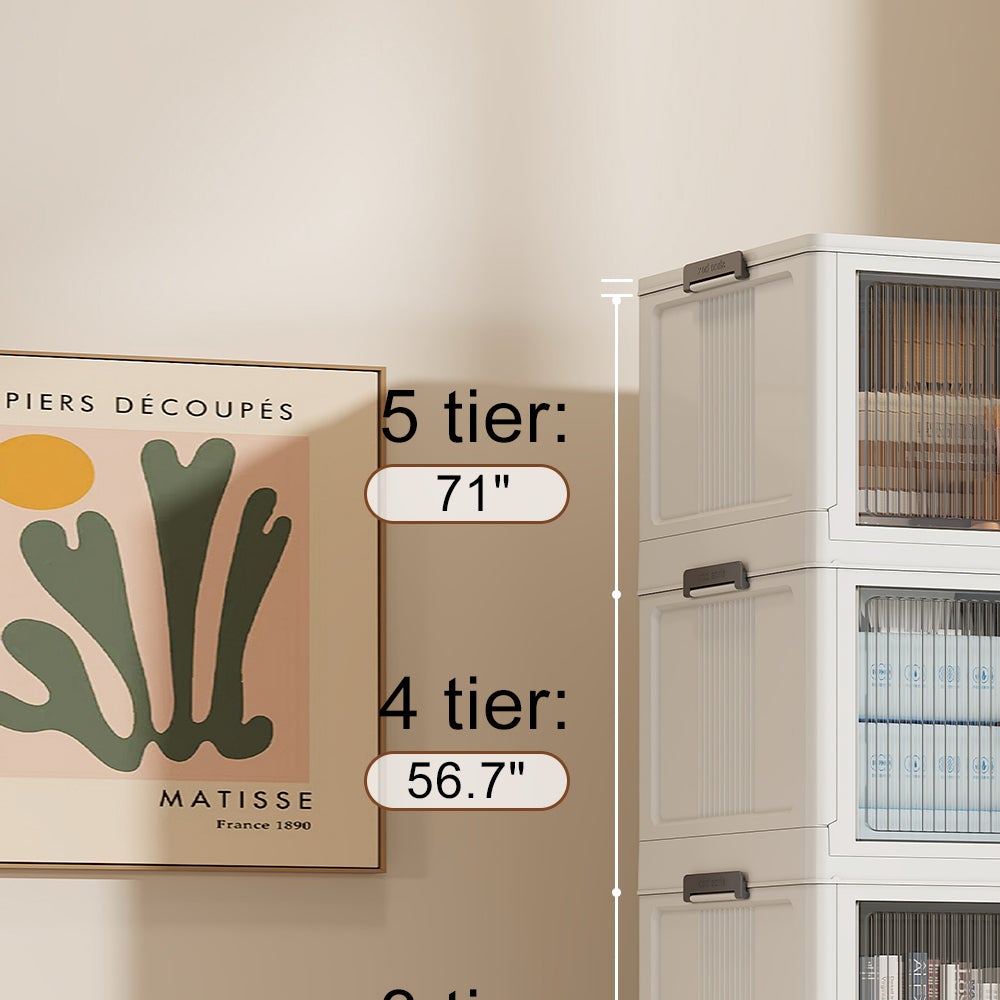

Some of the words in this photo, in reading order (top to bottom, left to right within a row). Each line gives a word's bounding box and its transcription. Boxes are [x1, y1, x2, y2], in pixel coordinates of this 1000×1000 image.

[6, 392, 94, 412] PIERS
[115, 393, 294, 421] DÉCOUPÉS
[159, 789, 312, 810] MATISSE
[216, 819, 271, 830] France
[276, 820, 312, 831] 1890
